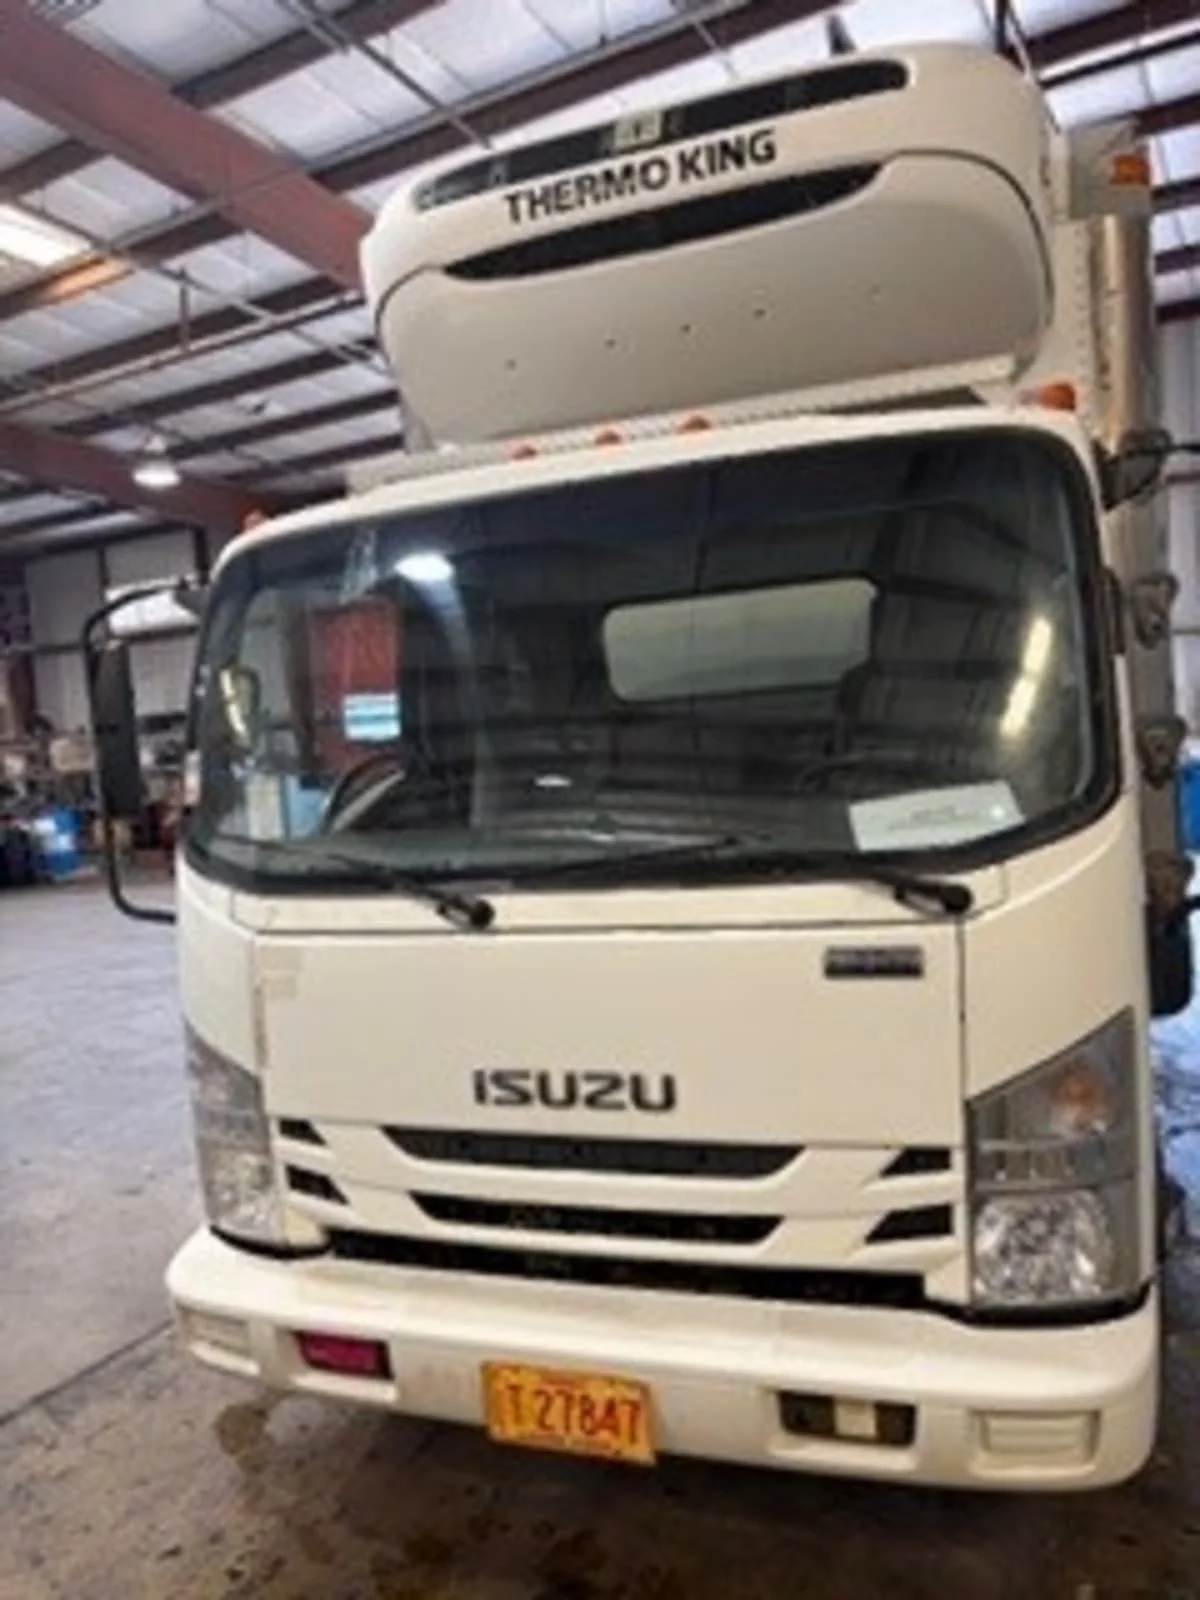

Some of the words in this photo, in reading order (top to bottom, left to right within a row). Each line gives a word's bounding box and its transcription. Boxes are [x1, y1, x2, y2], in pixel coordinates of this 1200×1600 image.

[504, 156, 671, 224] THERMO
[678, 127, 777, 184] KING
[473, 1068, 678, 1113] ISUZU
